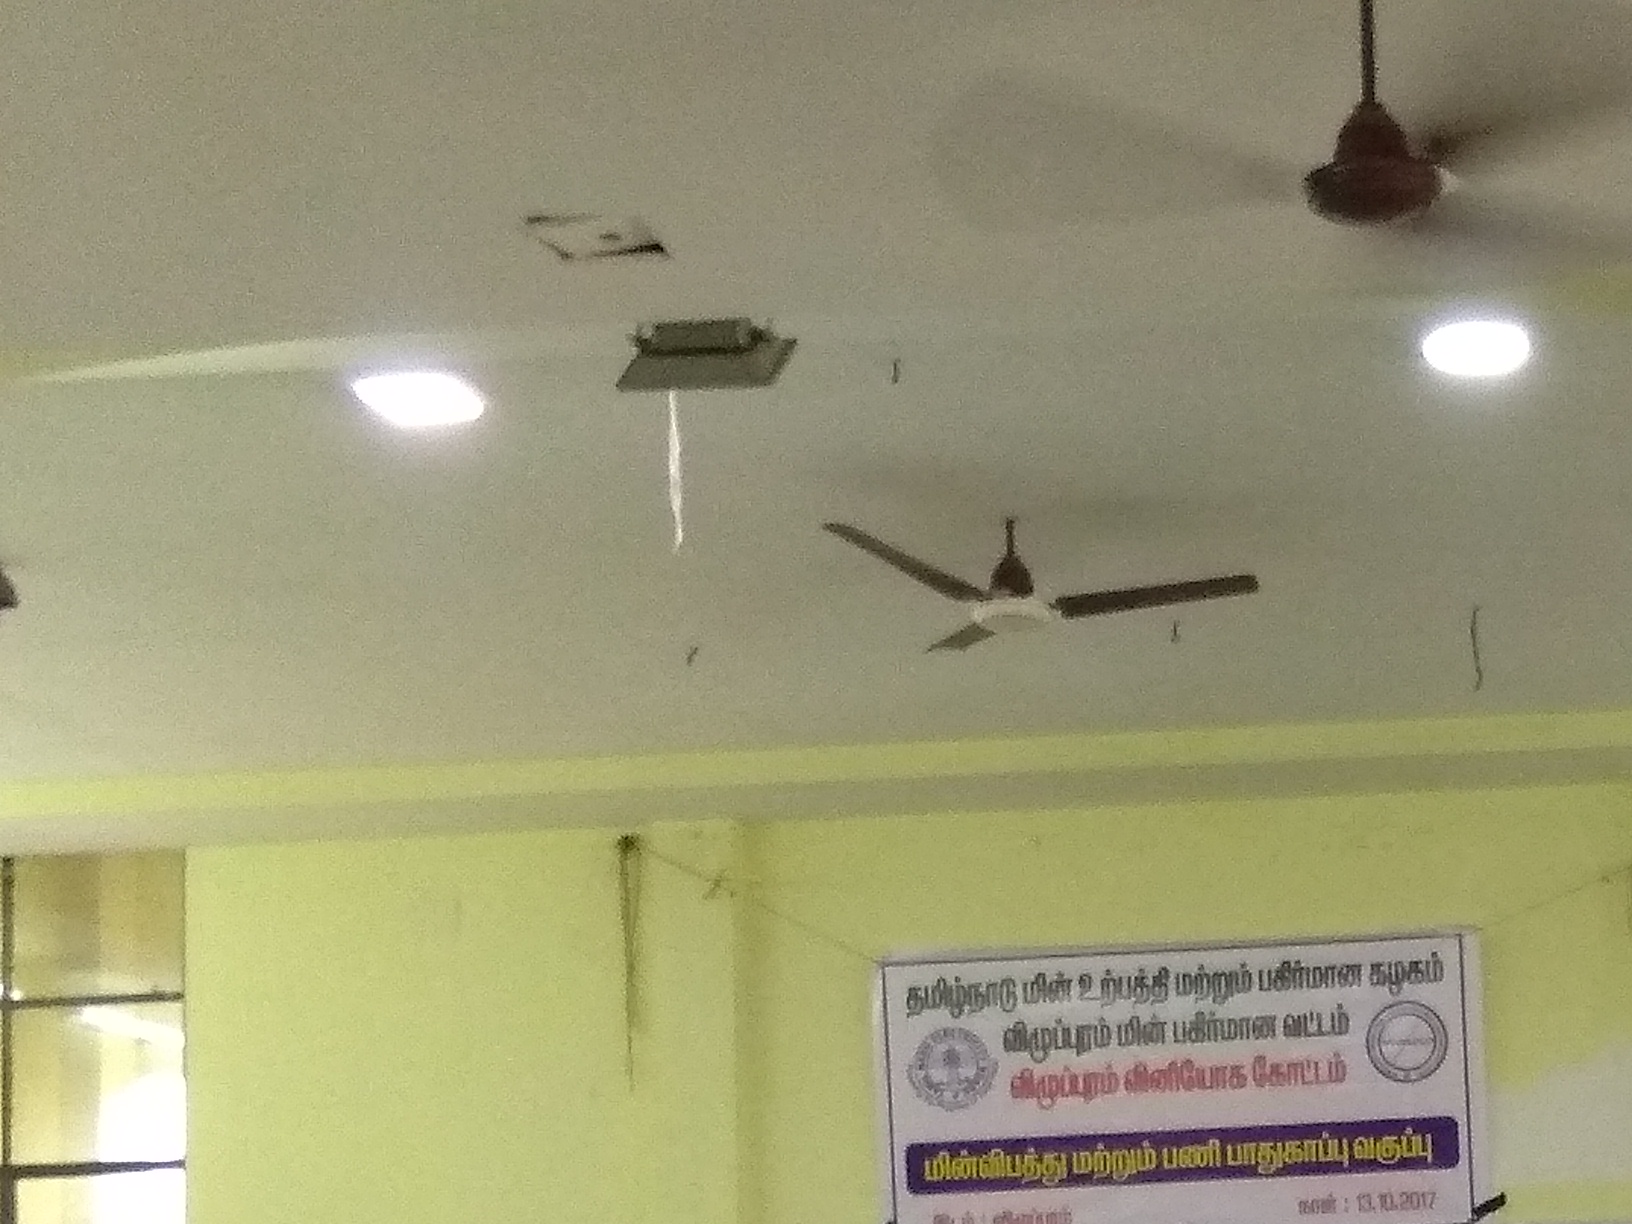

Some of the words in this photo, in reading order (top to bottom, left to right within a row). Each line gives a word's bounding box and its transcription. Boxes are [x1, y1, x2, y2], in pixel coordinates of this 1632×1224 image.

[1022, 971, 1072, 1004] மின்
[1175, 962, 1251, 1004] மற்றும்
[1369, 951, 1444, 996] கழகம்
[1117, 1014, 1166, 1046] மின்
[1283, 1003, 1349, 1037] வட்டம்
[1073, 1140, 1156, 1182] மற்றும்
[1162, 1139, 1221, 1168] பணி
[1356, 1191, 1437, 1215] 13.10.2017
